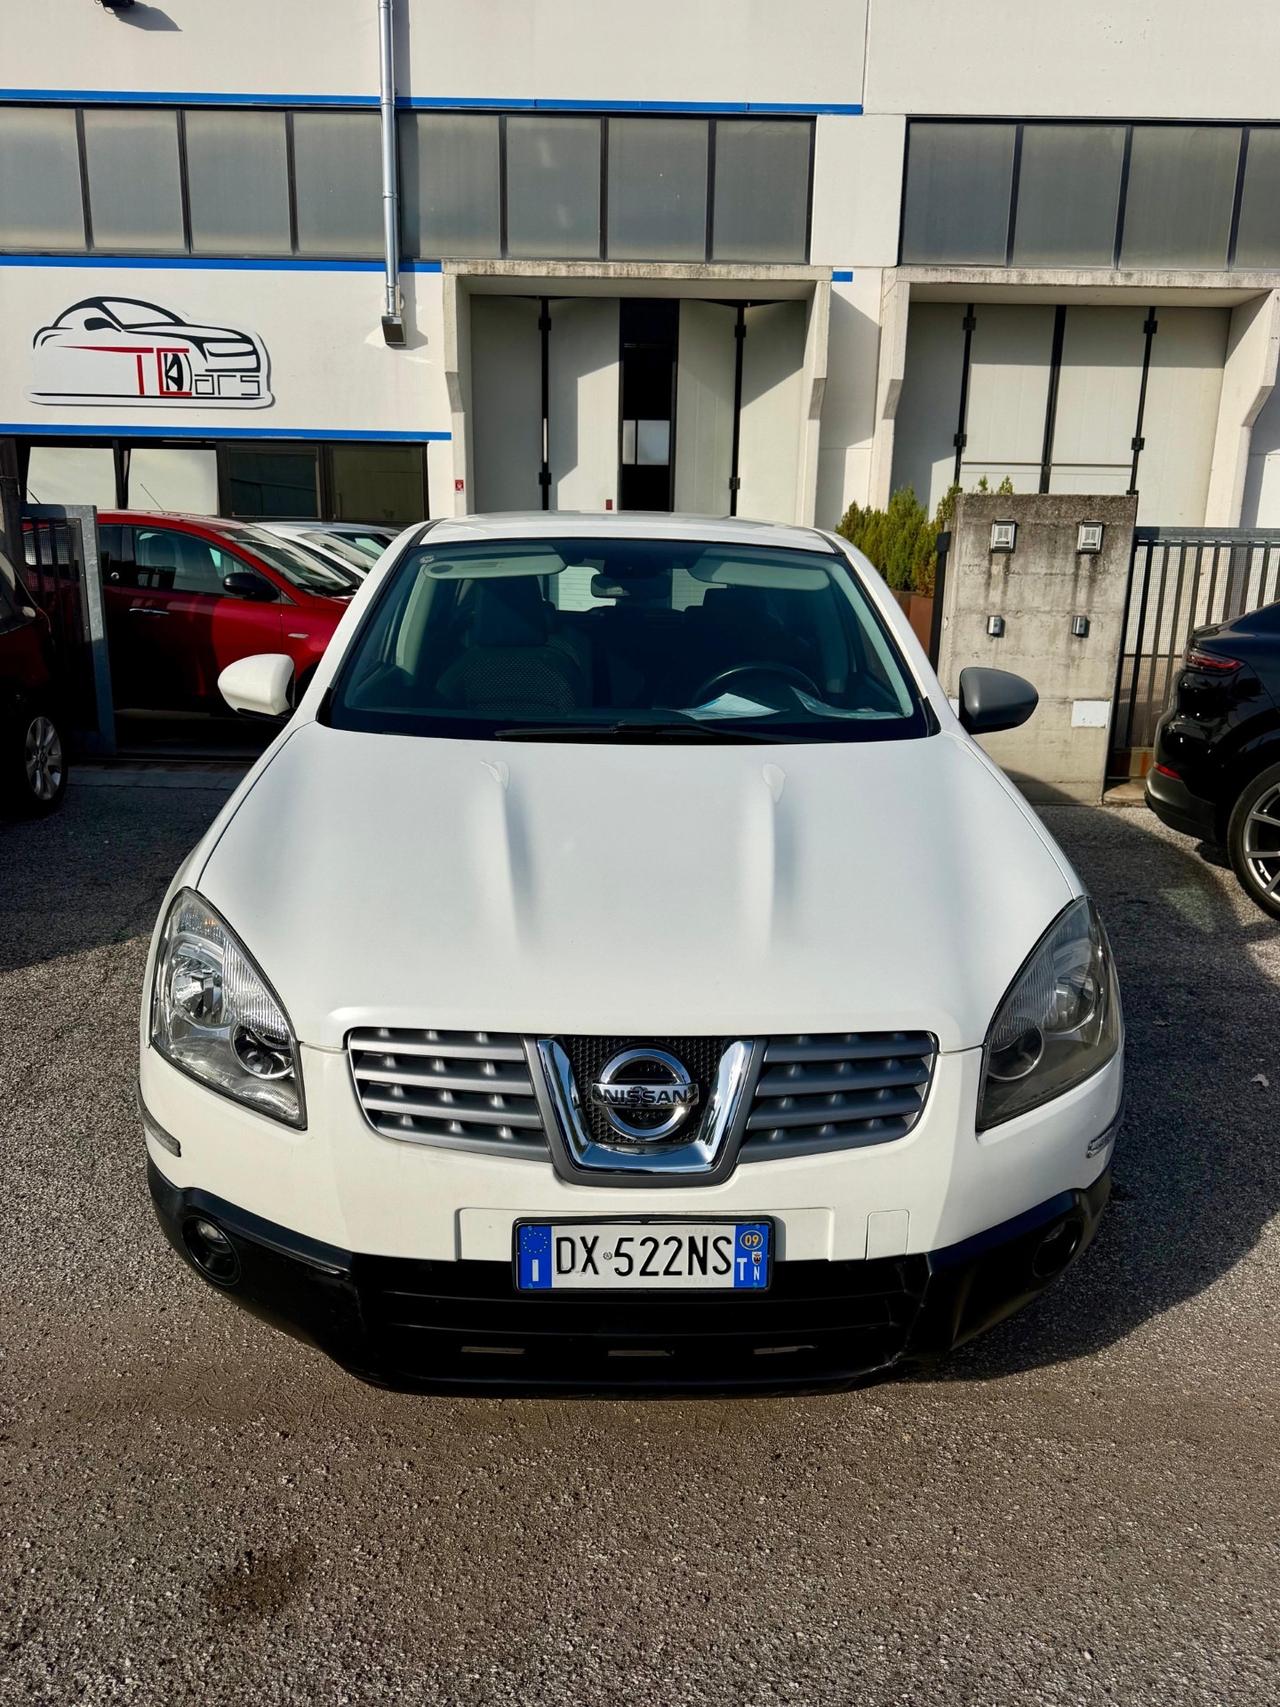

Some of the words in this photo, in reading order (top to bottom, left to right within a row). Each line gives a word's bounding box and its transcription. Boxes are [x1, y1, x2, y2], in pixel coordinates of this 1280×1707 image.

[604, 1088, 688, 1105] NISSAN
[745, 1234, 759, 1247] 09
[531, 1258, 540, 1282] I
